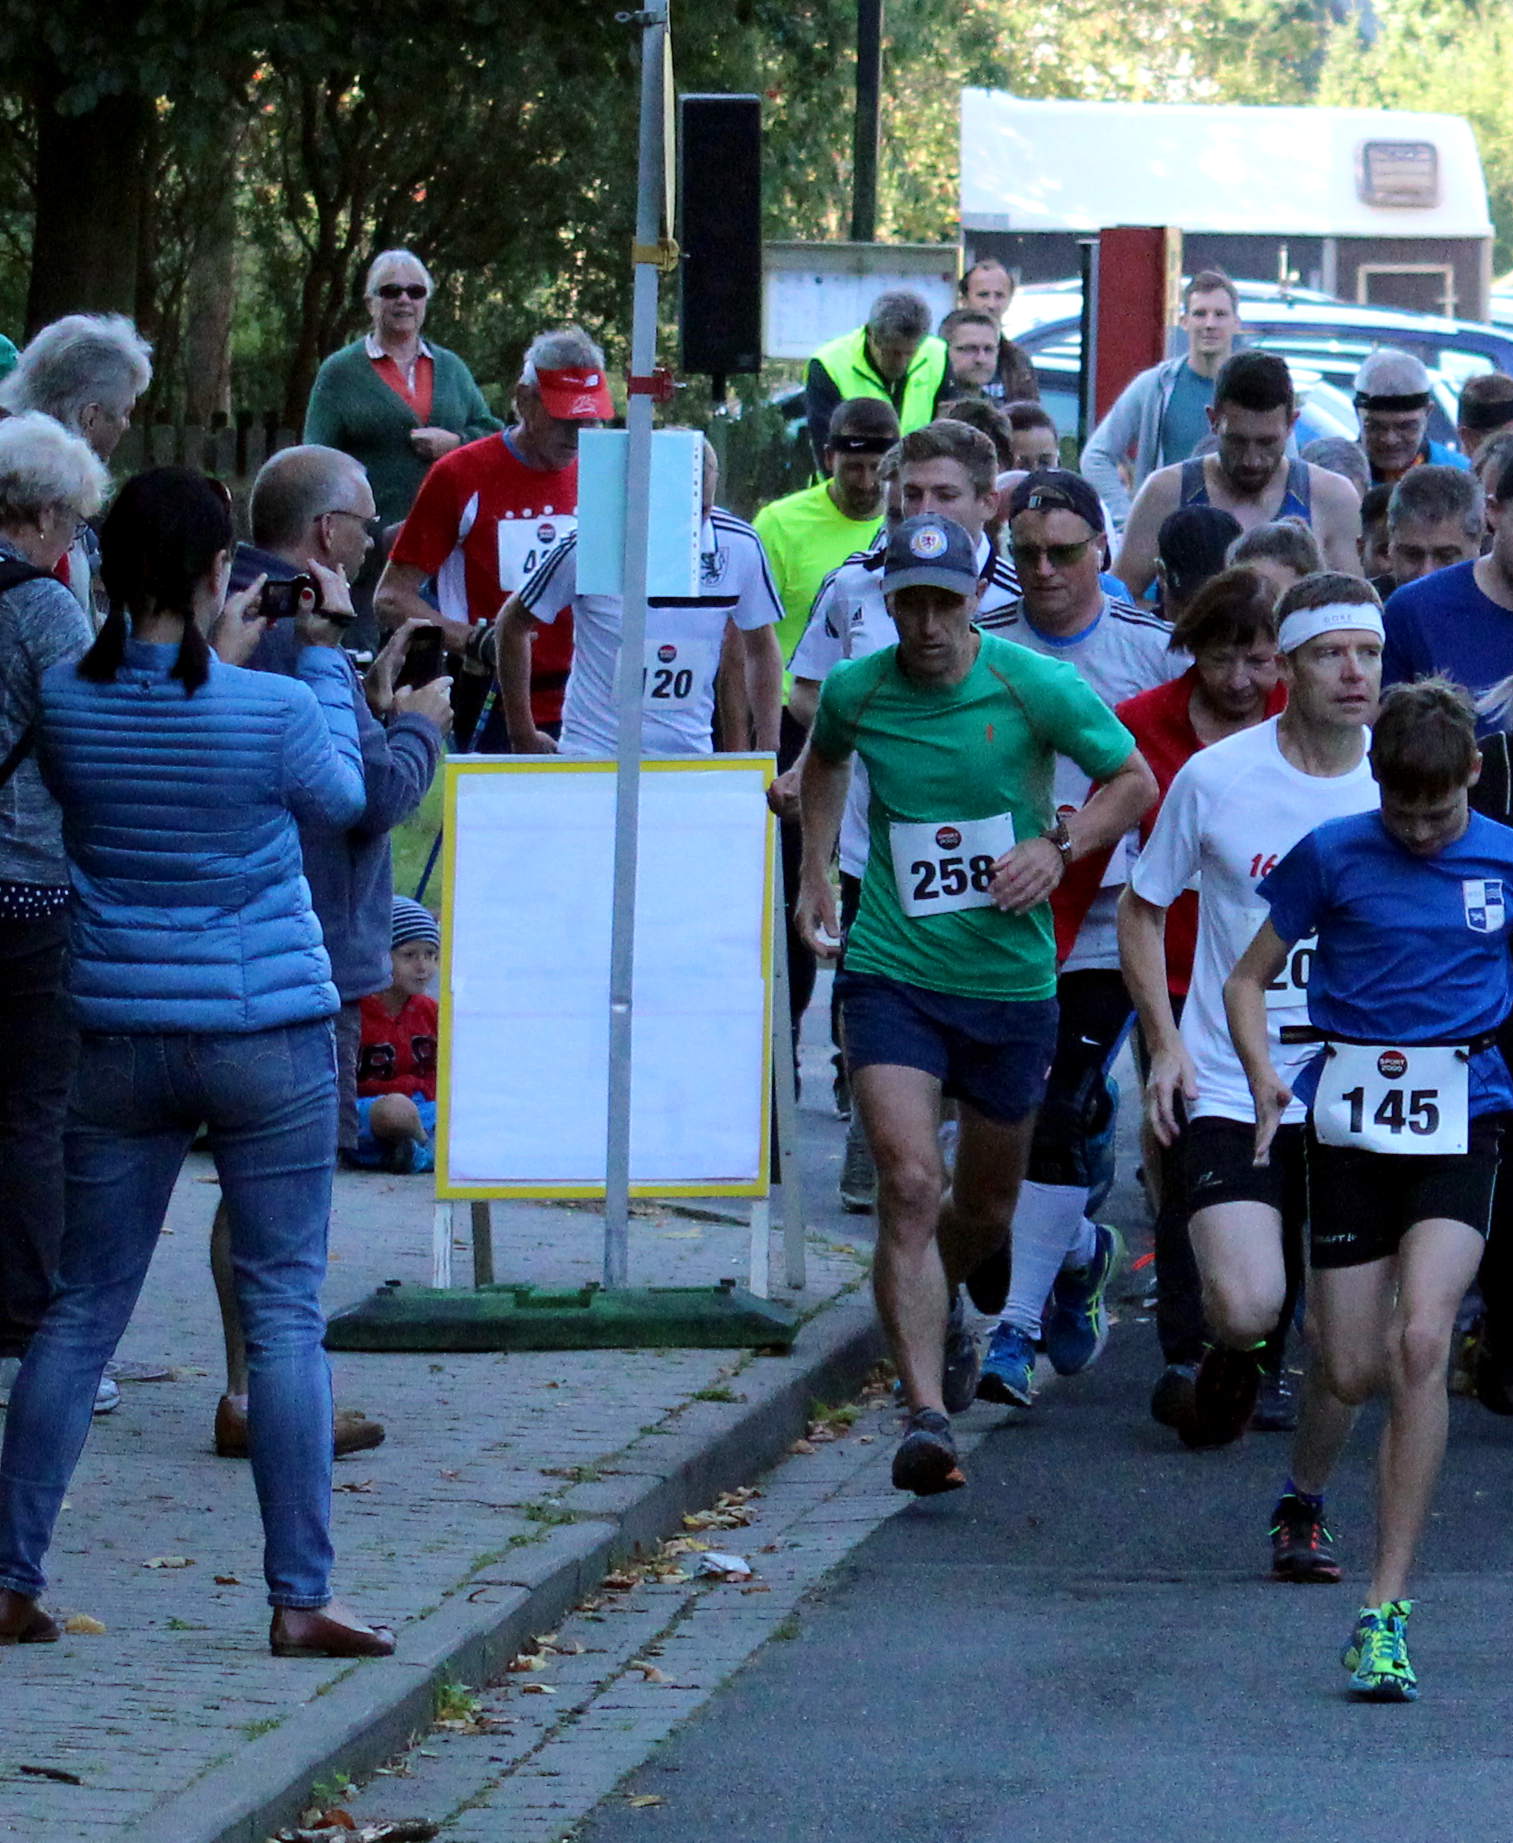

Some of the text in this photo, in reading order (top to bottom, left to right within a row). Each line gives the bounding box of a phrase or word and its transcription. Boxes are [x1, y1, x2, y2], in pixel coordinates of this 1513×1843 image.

[911, 854, 996, 900] 258
[1379, 1058, 1405, 1066] SPORT
[1381, 1064, 1403, 1072] 2000
[1342, 1087, 1440, 1136] 145
